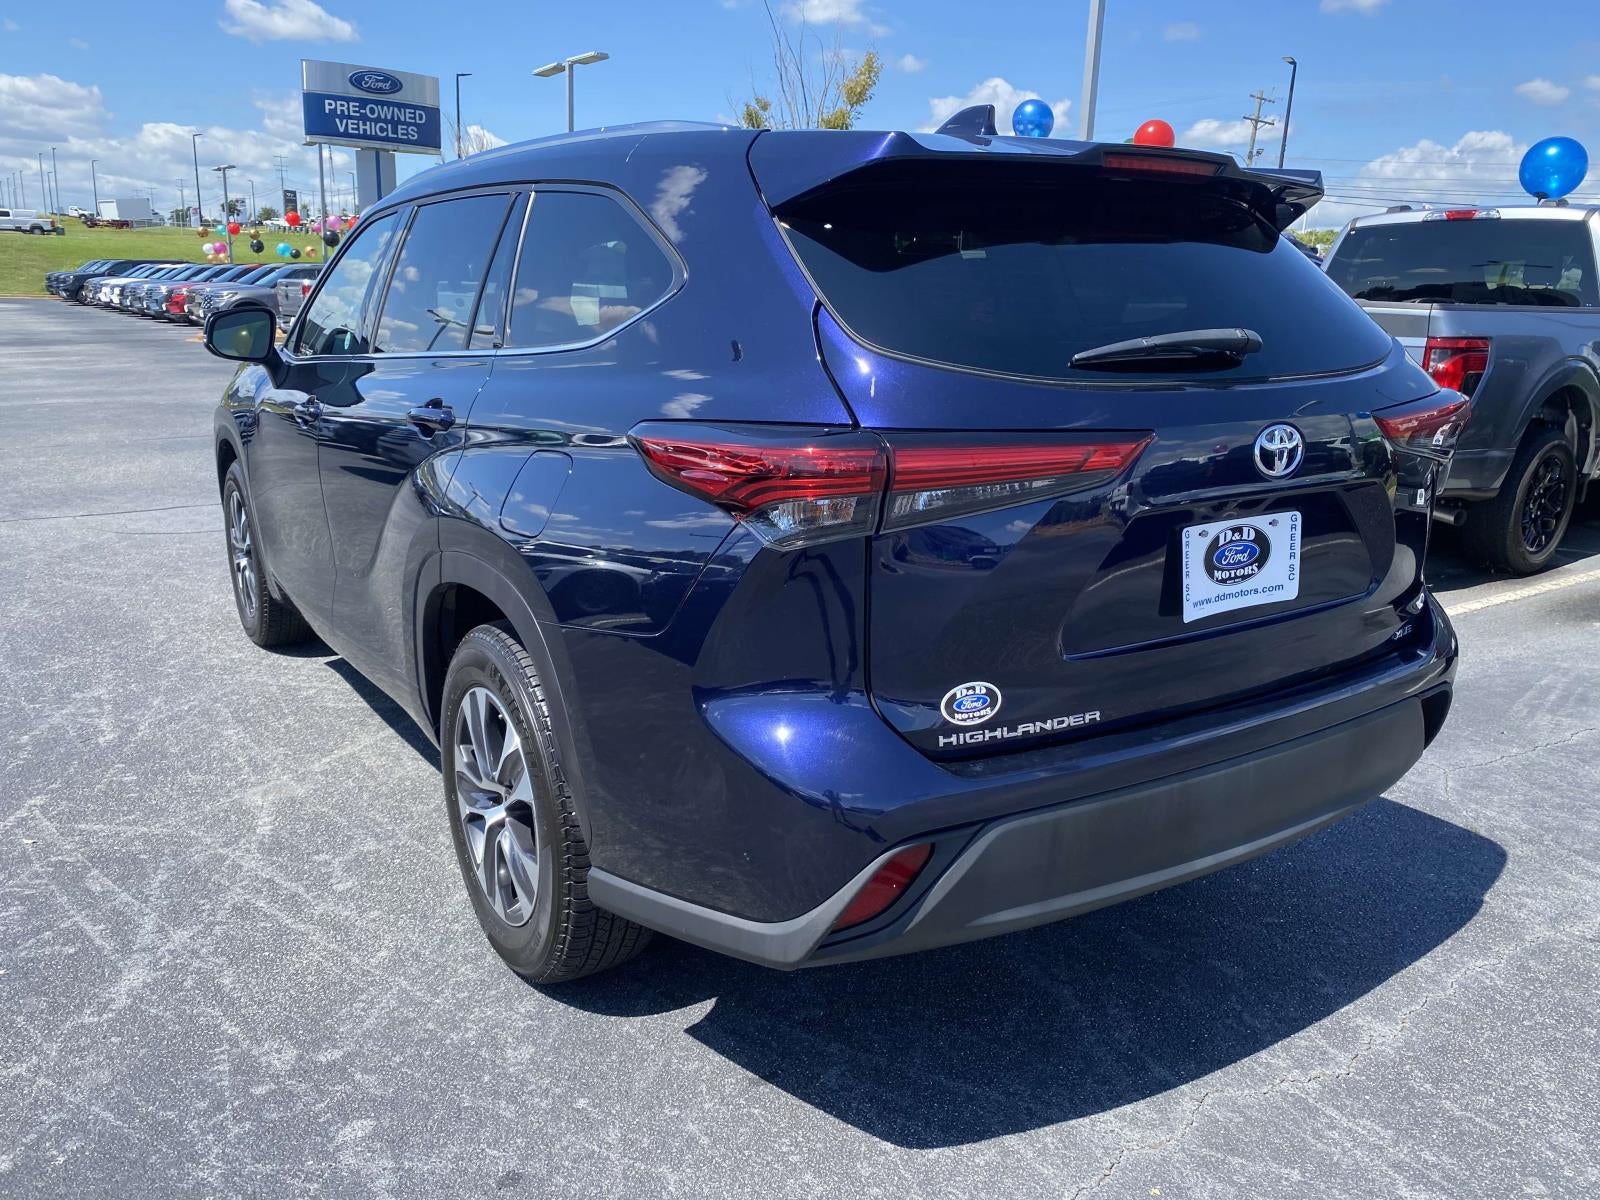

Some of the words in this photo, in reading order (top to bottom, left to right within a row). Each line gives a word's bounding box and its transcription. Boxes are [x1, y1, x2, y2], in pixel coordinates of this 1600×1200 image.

[361, 74, 392, 90] Ford
[324, 99, 426, 124] PRE-OWNED
[335, 118, 418, 140] VEHICLES
[1218, 526, 1256, 547] D&D
[1288, 513, 1298, 560] GREER
[1221, 545, 1250, 565] Ford
[1213, 563, 1259, 581] MOTORS
[1288, 563, 1295, 581] SC
[1185, 583, 1190, 602] SC
[1192, 583, 1284, 609] www.ddmotors.com
[955, 685, 987, 700] D&D
[960, 696, 983, 710] Ford
[954, 706, 992, 721] MOTORS
[938, 710, 1101, 748] HIGHLANDER
